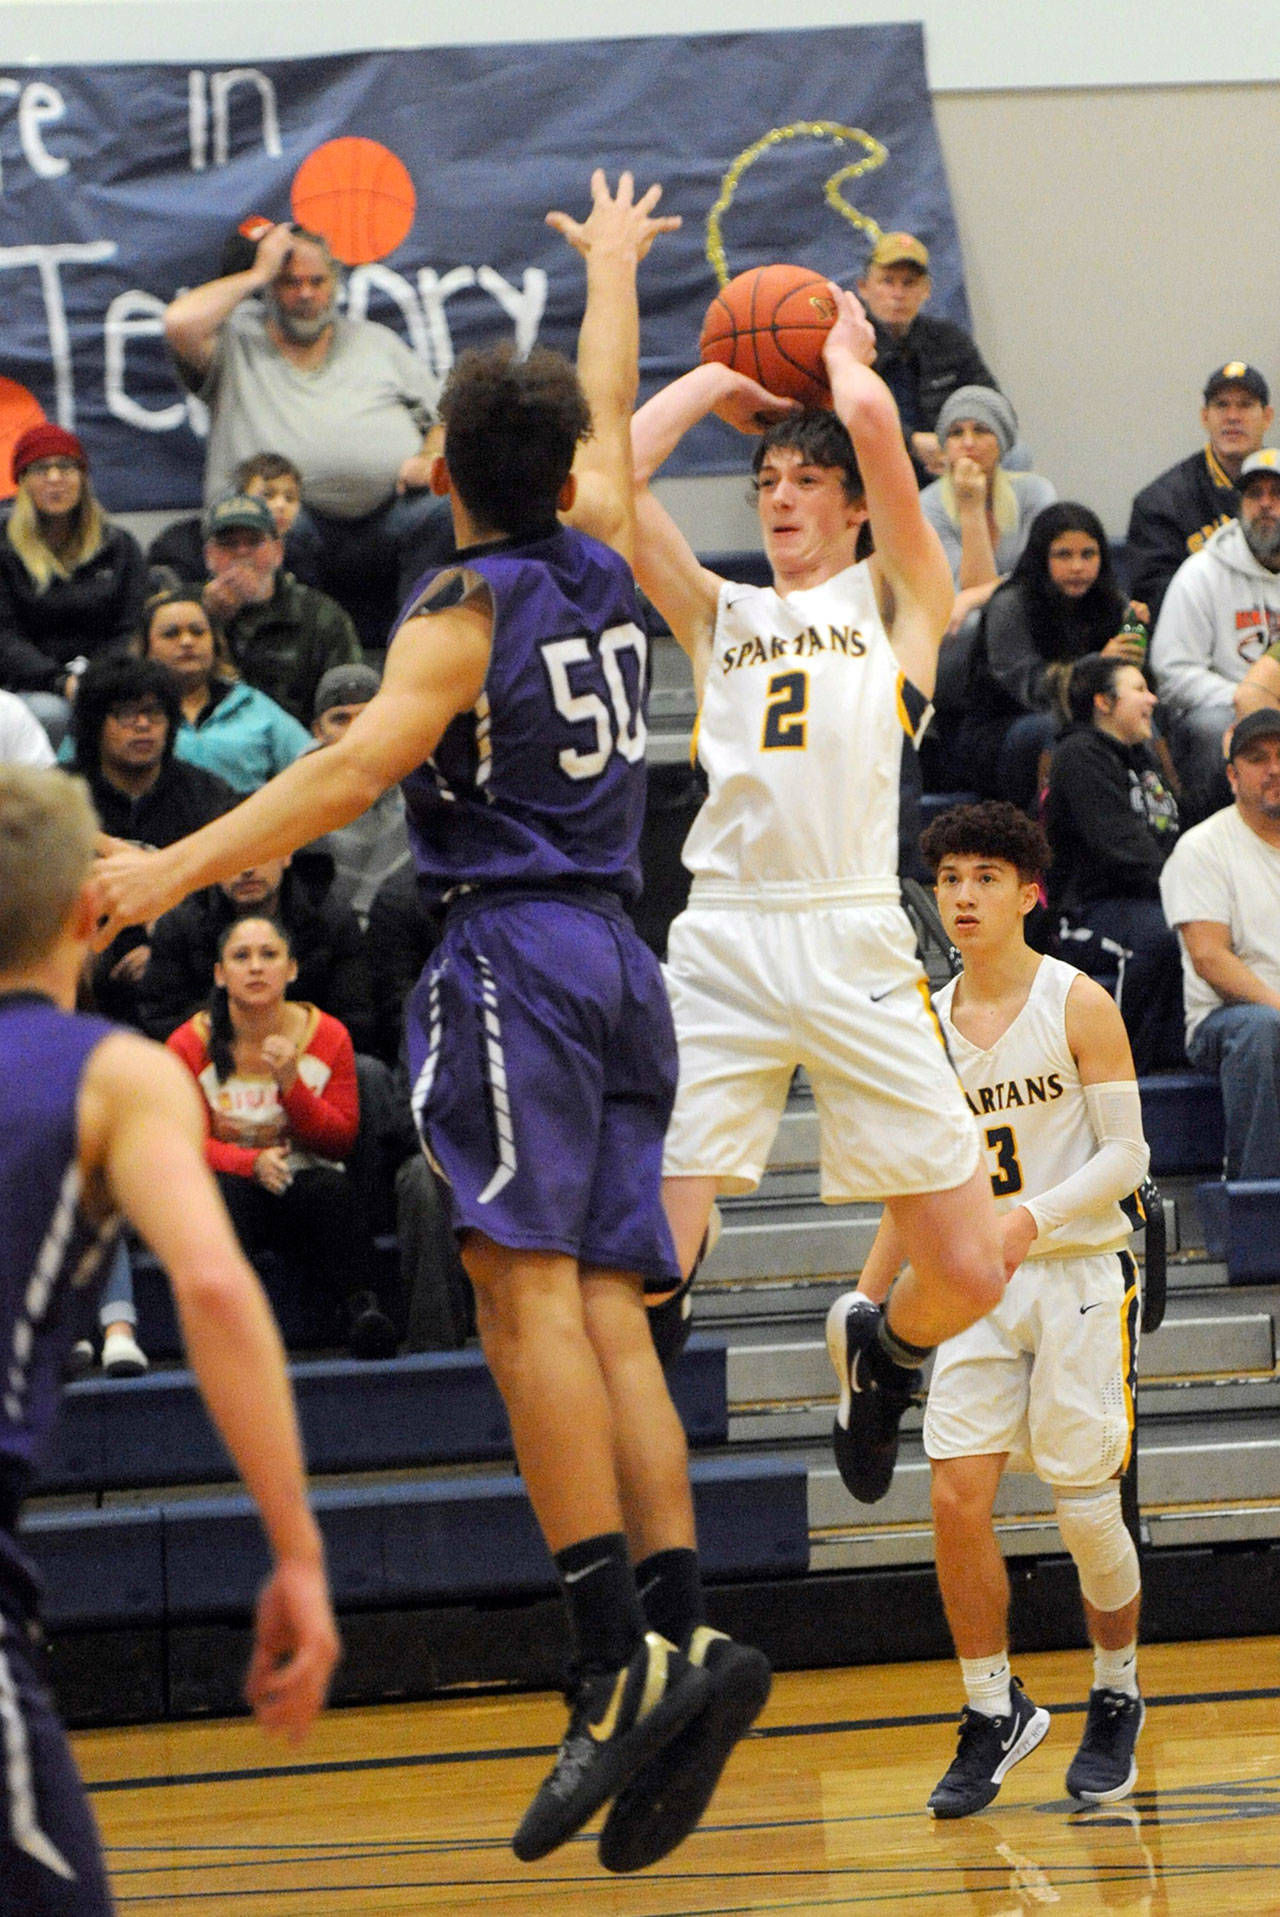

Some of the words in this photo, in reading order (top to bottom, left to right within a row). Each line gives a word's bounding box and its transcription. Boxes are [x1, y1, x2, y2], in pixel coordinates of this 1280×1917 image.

[723, 625, 867, 674] SPARTANS
[540, 622, 648, 781] 50
[760, 667, 811, 752] 2
[984, 1123, 1024, 1199] 3
